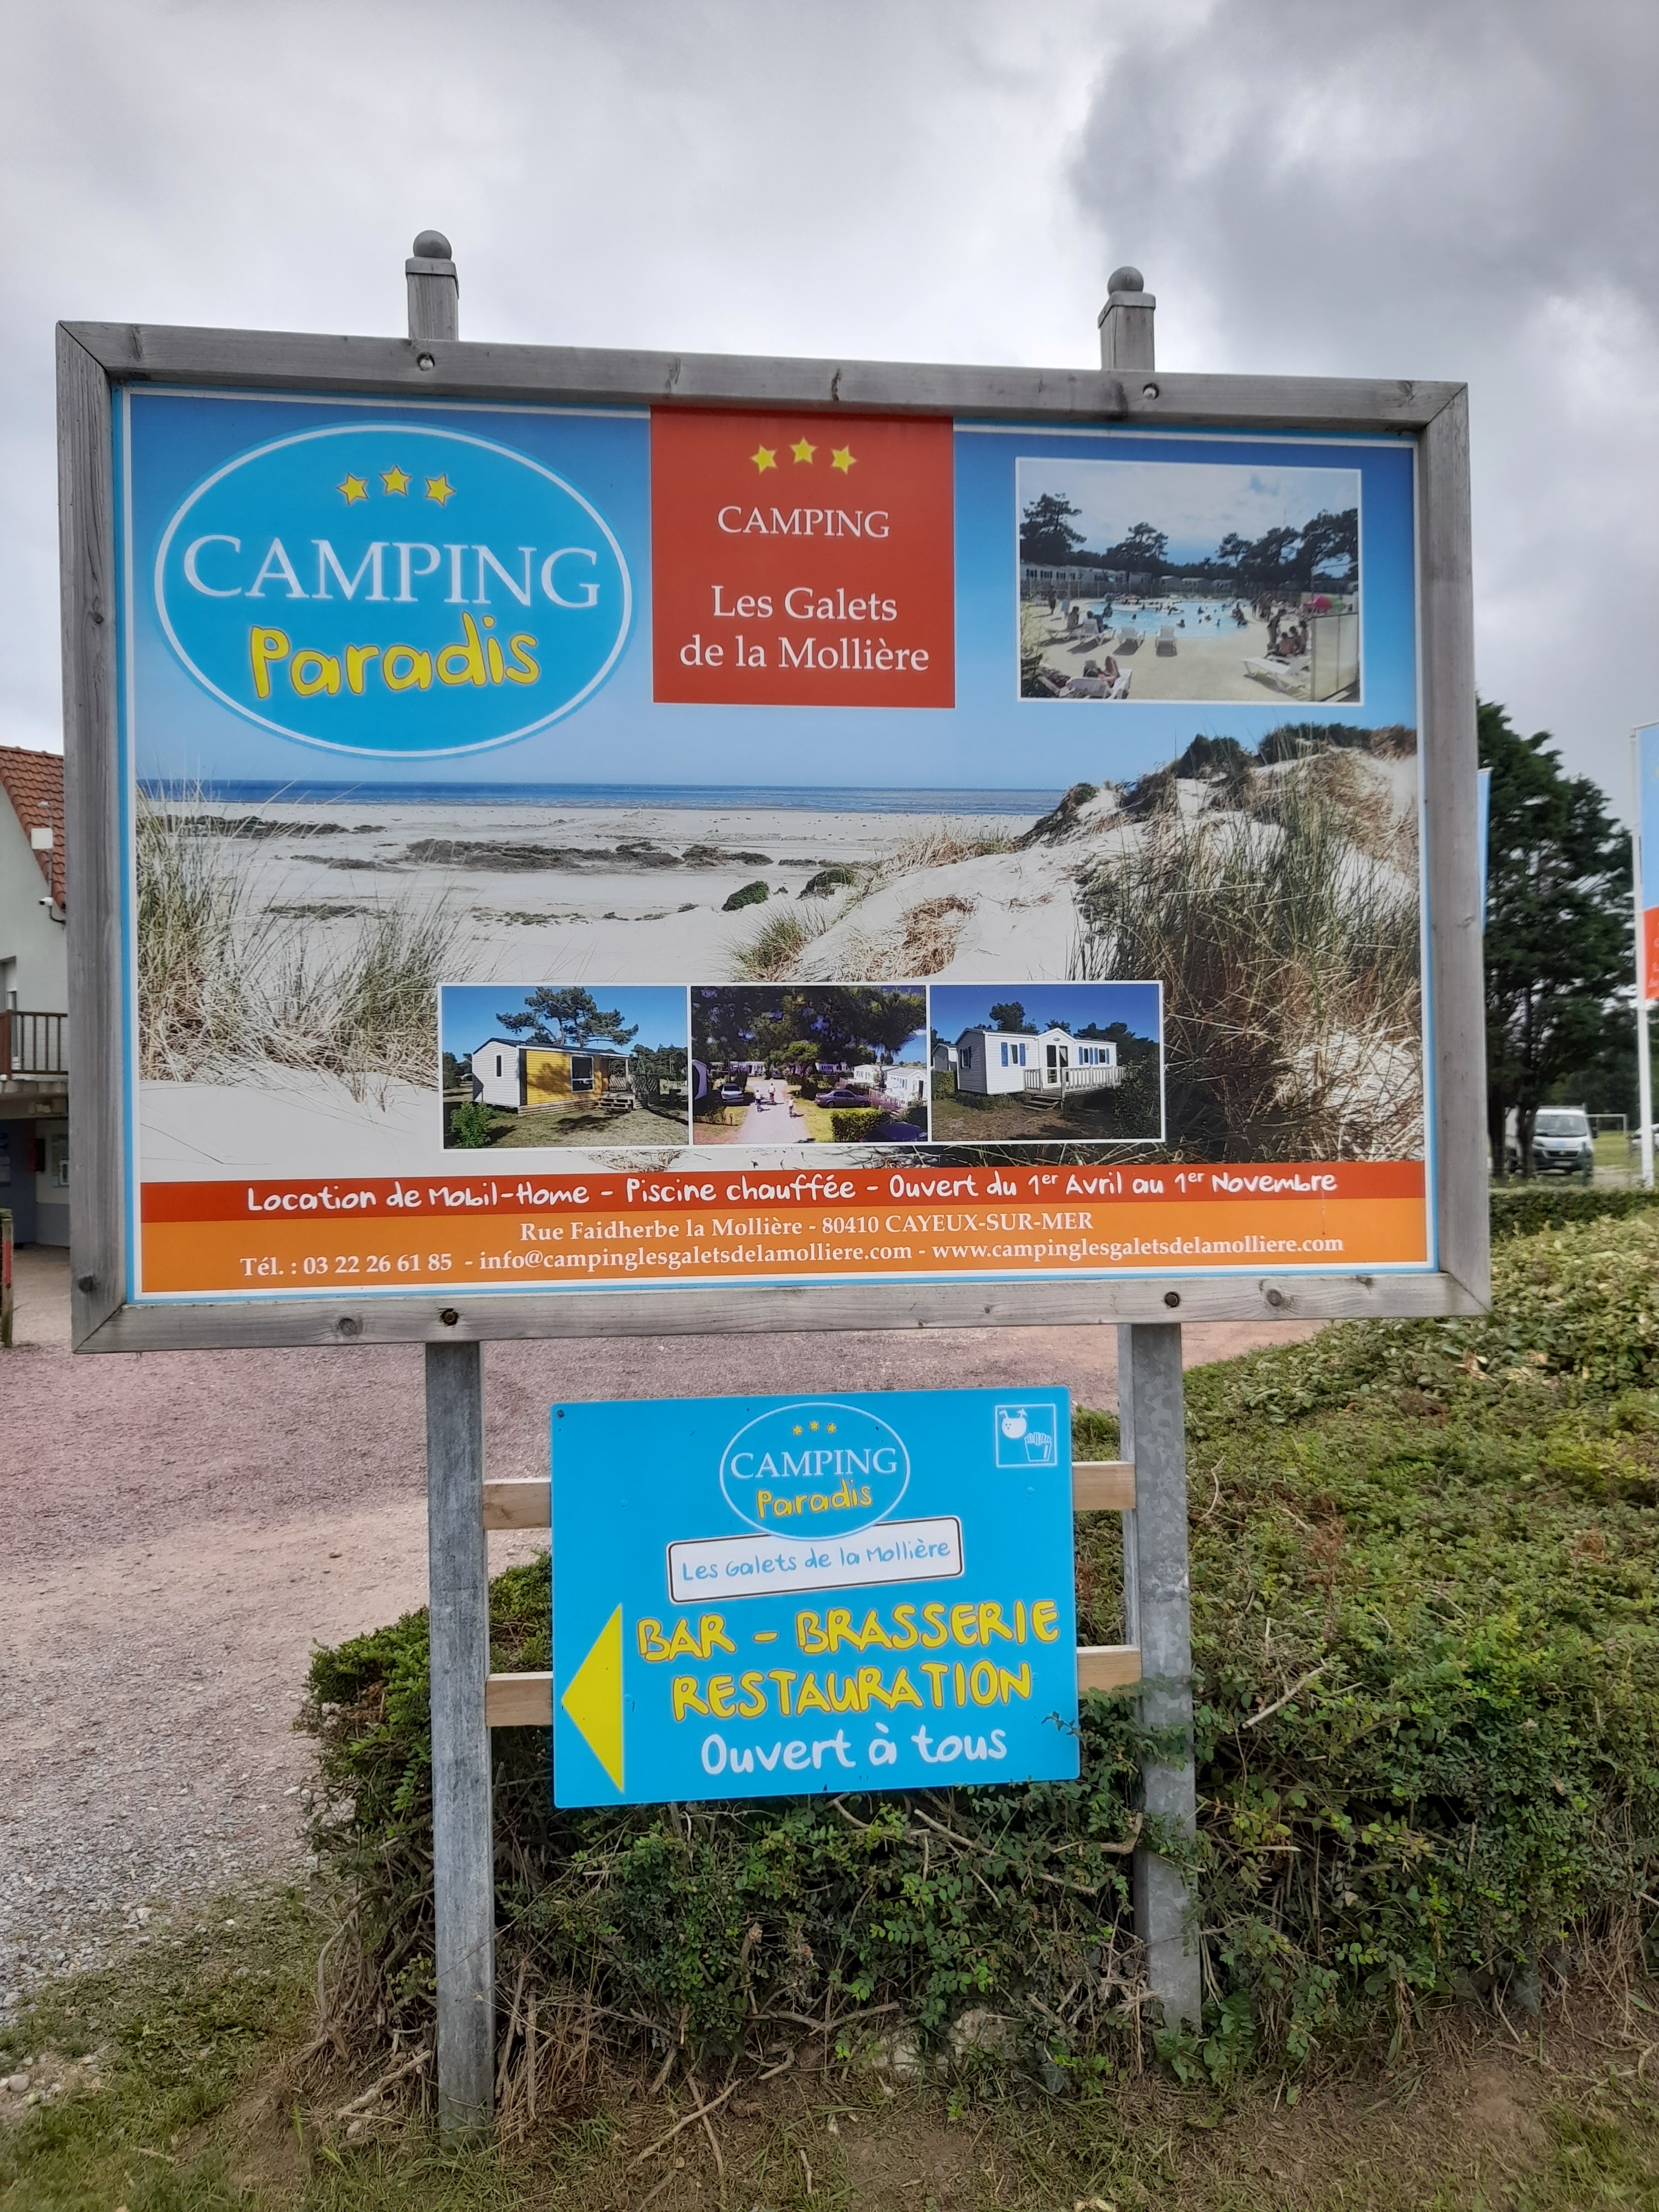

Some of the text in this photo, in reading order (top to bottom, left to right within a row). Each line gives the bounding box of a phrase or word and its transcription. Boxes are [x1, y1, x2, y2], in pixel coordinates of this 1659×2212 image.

[717, 505, 890, 538] CAMPING
[183, 534, 600, 608] CAMPING
[711, 585, 898, 621] Les Galets
[249, 611, 541, 698] Paradis
[679, 633, 930, 671] de la Mollière
[247, 1185, 377, 1212] Location
[385, 1181, 422, 1208] de
[429, 1181, 590, 1207] Mobil-Home
[626, 1177, 717, 1203] Piscine
[726, 1173, 857, 1202] chauffée
[889, 1173, 979, 1198] Ouvert
[986, 1170, 1017, 1196] du
[1027, 1173, 1059, 1195] 1er
[1065, 1170, 1122, 1194] Avril
[1132, 1177, 1164, 1193] au
[1174, 1172, 1206, 1193] 1er
[1211, 1172, 1339, 1193] Novembre
[520, 1223, 564, 1241] Rue
[570, 1219, 680, 1240] Faidherbe
[686, 1218, 706, 1238] la
[711, 1216, 803, 1238] Mollière
[822, 1215, 879, 1235] 80410
[885, 1211, 1093, 1233] CAYEUX-SUR-MER
[240, 1256, 284, 1276] Tél.
[303, 1256, 328, 1275] 03
[335, 1255, 360, 1274] 22
[365, 1254, 390, 1272] 26
[397, 1253, 421, 1272] 61
[427, 1253, 452, 1271] 85
[479, 1242, 912, 1272] info@campinglesgaletsdelamolliere.com
[932, 1235, 1344, 1262] www.campinglesgaletsdelamolliere.com
[729, 1447, 898, 1480] CAMPING
[755, 1478, 873, 1519] Paradis
[682, 1540, 951, 1581] Les Galets de la Mollière
[637, 1613, 737, 1662] BAR
[795, 1599, 1060, 1654] BRASSERIE
[672, 1660, 1032, 1721] RESTAURATION
[701, 1721, 1008, 1775] Ouvert à tous
